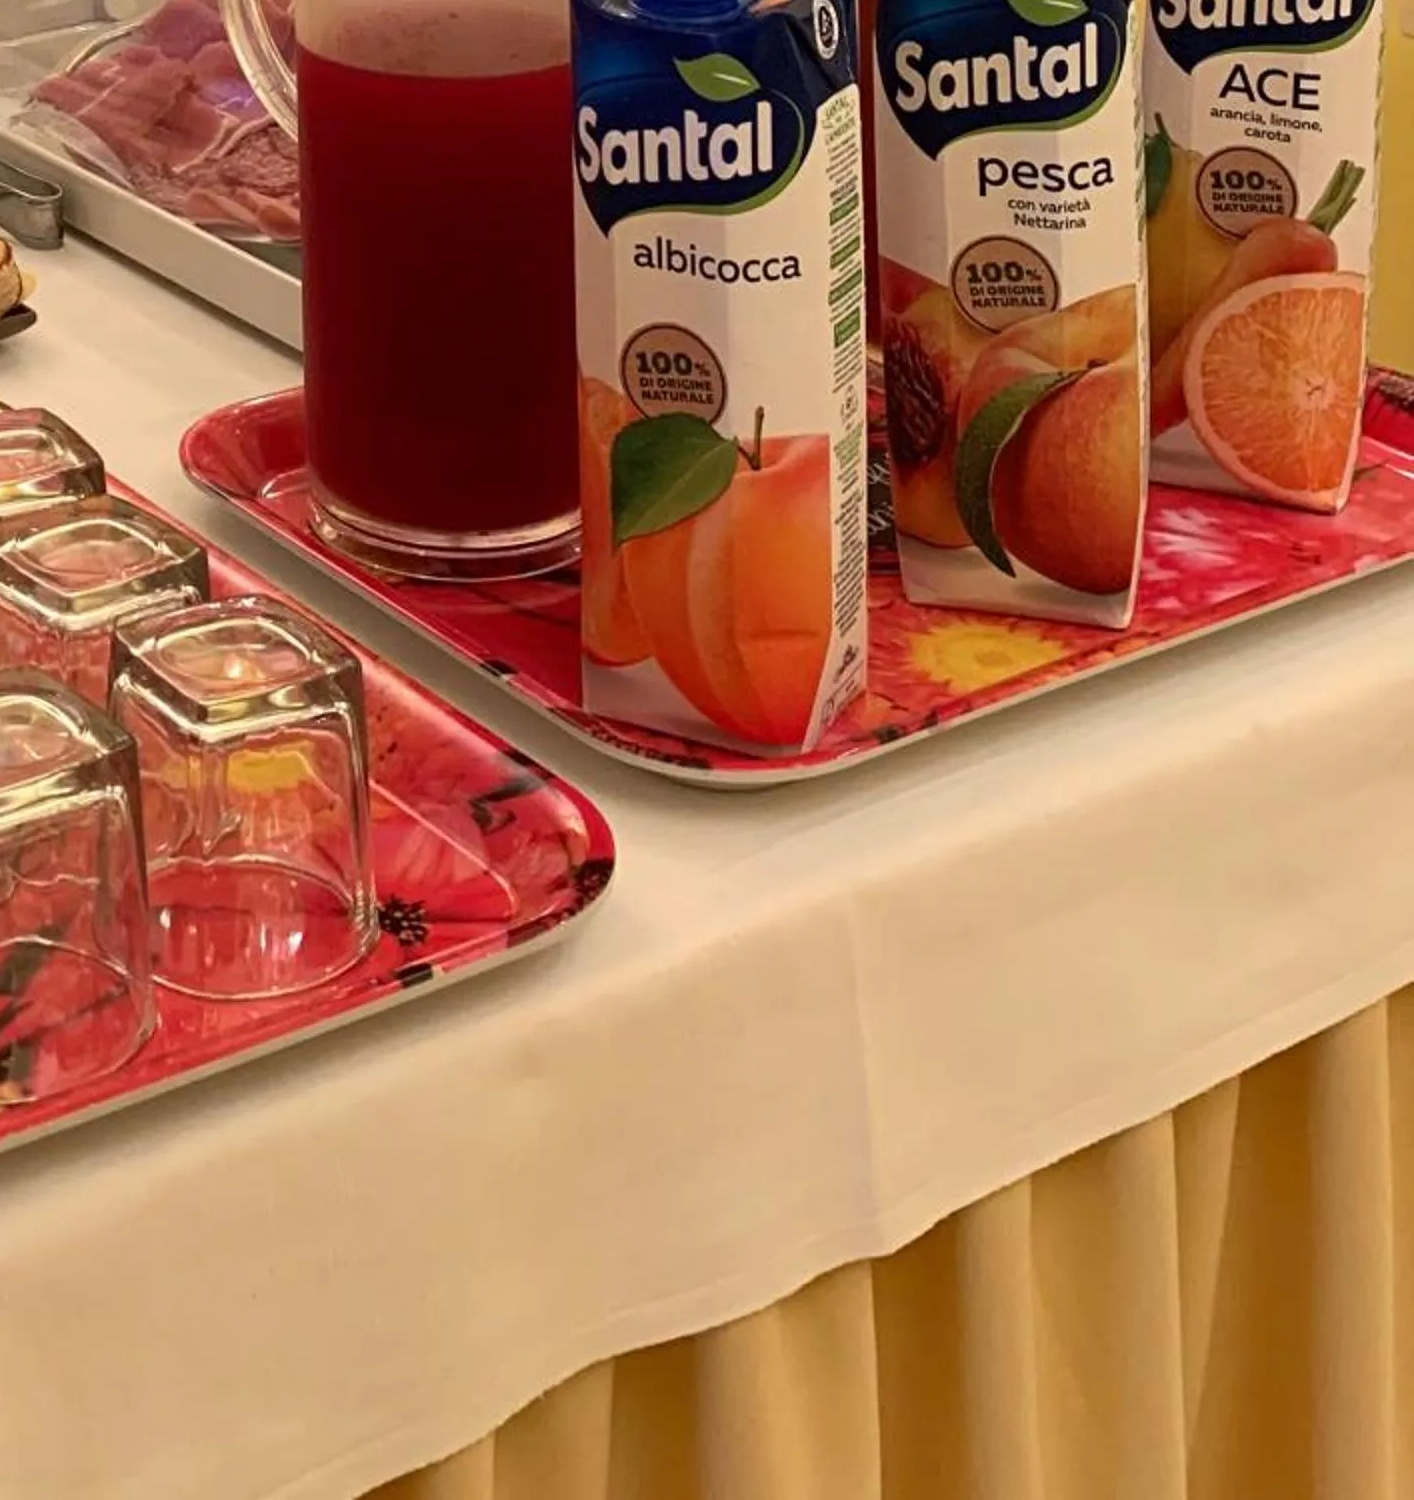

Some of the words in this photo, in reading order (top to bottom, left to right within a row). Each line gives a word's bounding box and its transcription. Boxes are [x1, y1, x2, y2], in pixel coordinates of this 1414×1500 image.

[894, 22, 1098, 112] Santal
[1218, 63, 1321, 111] ACE
[1210, 107, 1266, 125] arancia,
[1269, 113, 1323, 132] limone,
[578, 100, 773, 186] Santal
[1244, 127, 1291, 142] carota
[978, 157, 1114, 197] pesca
[1209, 169, 1283, 191] 100%
[1007, 199, 1036, 211] con
[1014, 212, 1087, 231] Nettarina
[633, 235, 801, 283] albicocca
[966, 261, 1044, 283] 100%
[636, 351, 710, 376] 100%
